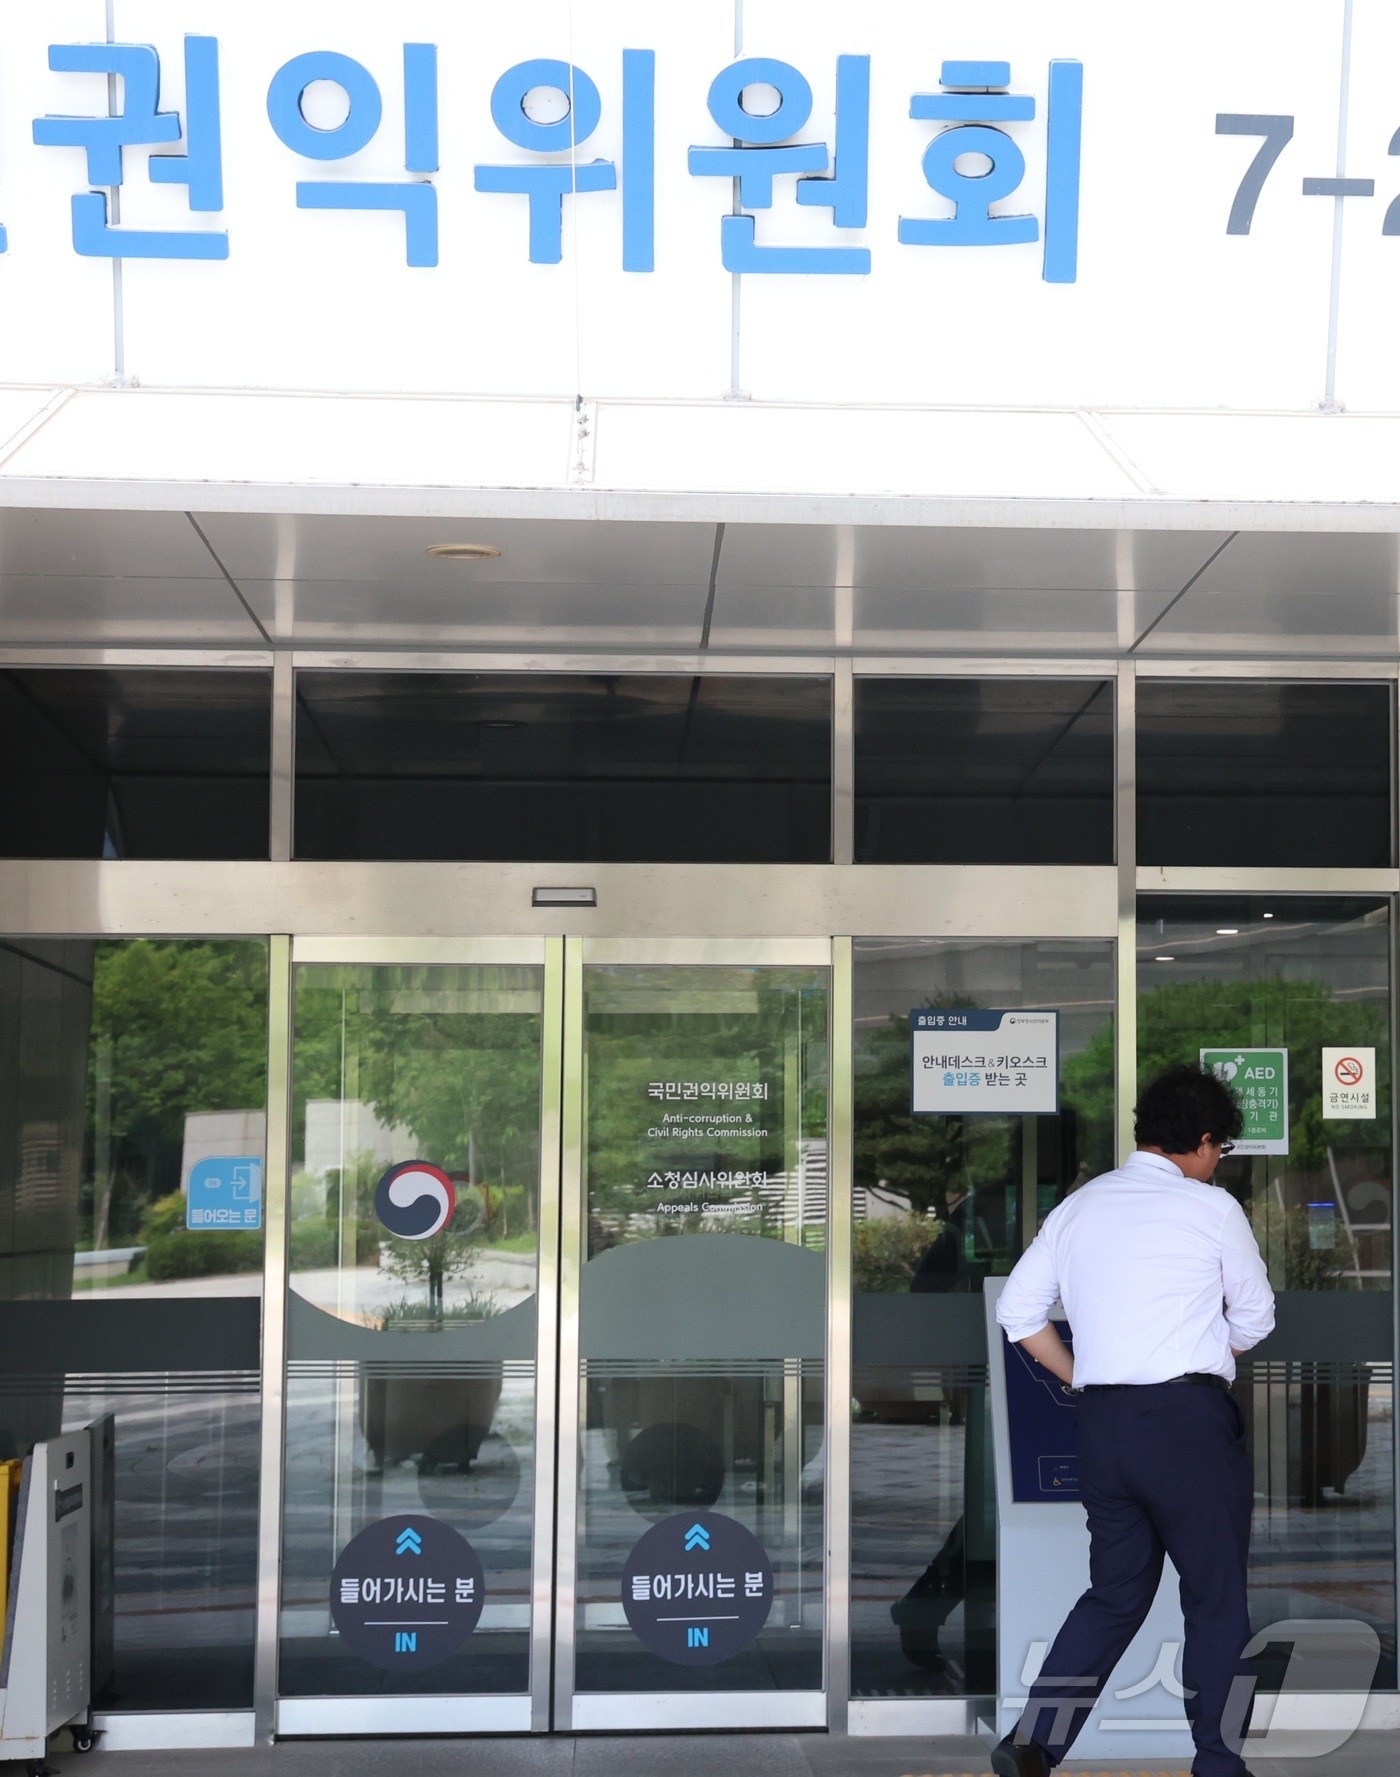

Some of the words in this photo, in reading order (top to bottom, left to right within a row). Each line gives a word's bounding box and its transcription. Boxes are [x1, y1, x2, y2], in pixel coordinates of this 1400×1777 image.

[0, 33, 1083, 283] 권익위원회
[1215, 113, 1400, 236] 7-
[917, 1015, 945, 1026] 출입증
[948, 1015, 967, 1026] 안내
[942, 1072, 981, 1087] 출입증
[985, 1072, 1011, 1087] 받는
[1014, 1072, 1028, 1087] 곳
[1244, 1066, 1276, 1080] AED
[648, 1082, 768, 1100] 국민권익위원회
[1329, 1093, 1370, 1104] 금연시설
[662, 1114, 742, 1125] Anti-corruption
[745, 1114, 753, 1123] &
[647, 1128, 669, 1137] Civil
[672, 1127, 704, 1139] Rights
[706, 1127, 768, 1138] Commission
[647, 1171, 768, 1190] 소청심사위원회
[657, 1202, 699, 1213] Appeals
[701, 1202, 763, 1212] Commission
[191, 1209, 241, 1223] 들어오는
[244, 1209, 257, 1223] 문
[340, 1577, 447, 1604] 들어가시는
[454, 1577, 475, 1604] 분
[631, 1573, 736, 1600] 들어가시는
[744, 1571, 764, 1598] 분
[395, 1632, 417, 1653] IN
[687, 1627, 709, 1648] IN
